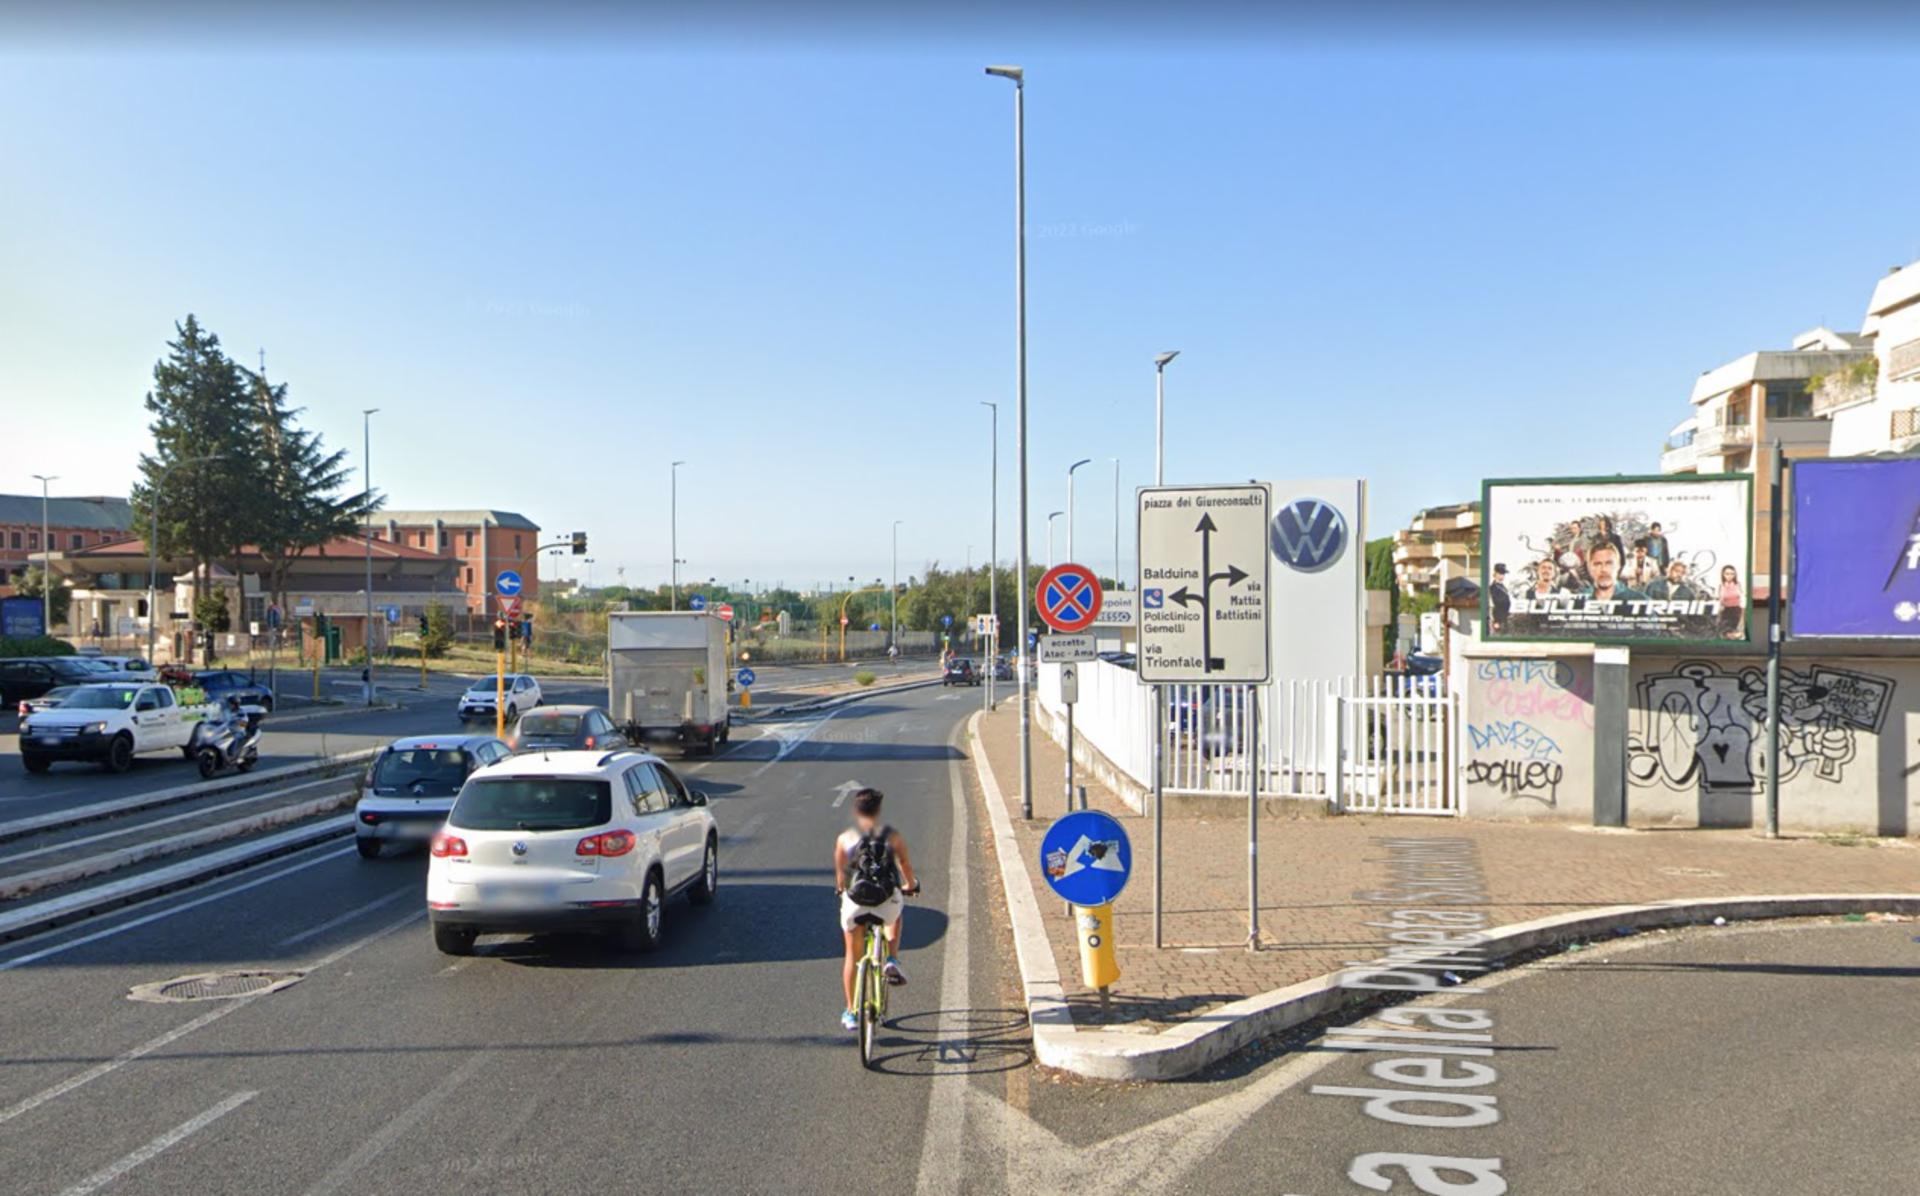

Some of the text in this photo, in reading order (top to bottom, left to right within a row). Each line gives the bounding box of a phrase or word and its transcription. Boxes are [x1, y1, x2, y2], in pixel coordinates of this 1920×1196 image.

[1144, 494, 1262, 511] piazza dei Giureconsulti
[1143, 568, 1199, 579] Balduina
[1247, 581, 1261, 592] via
[1104, 598, 1132, 608] rpoint
[1230, 595, 1261, 606] Mattia
[1508, 599, 1721, 615] BULLET TRAIN
[1144, 611, 1200, 621] Policlinico
[1215, 609, 1262, 621] Battistini
[1144, 623, 1185, 634] Gemelli
[1051, 638, 1086, 647] eccetto
[1044, 650, 1065, 658] Atac
[1074, 648, 1094, 657] Ama
[1145, 644, 1162, 654] via
[1145, 656, 1203, 668] Trionfale
